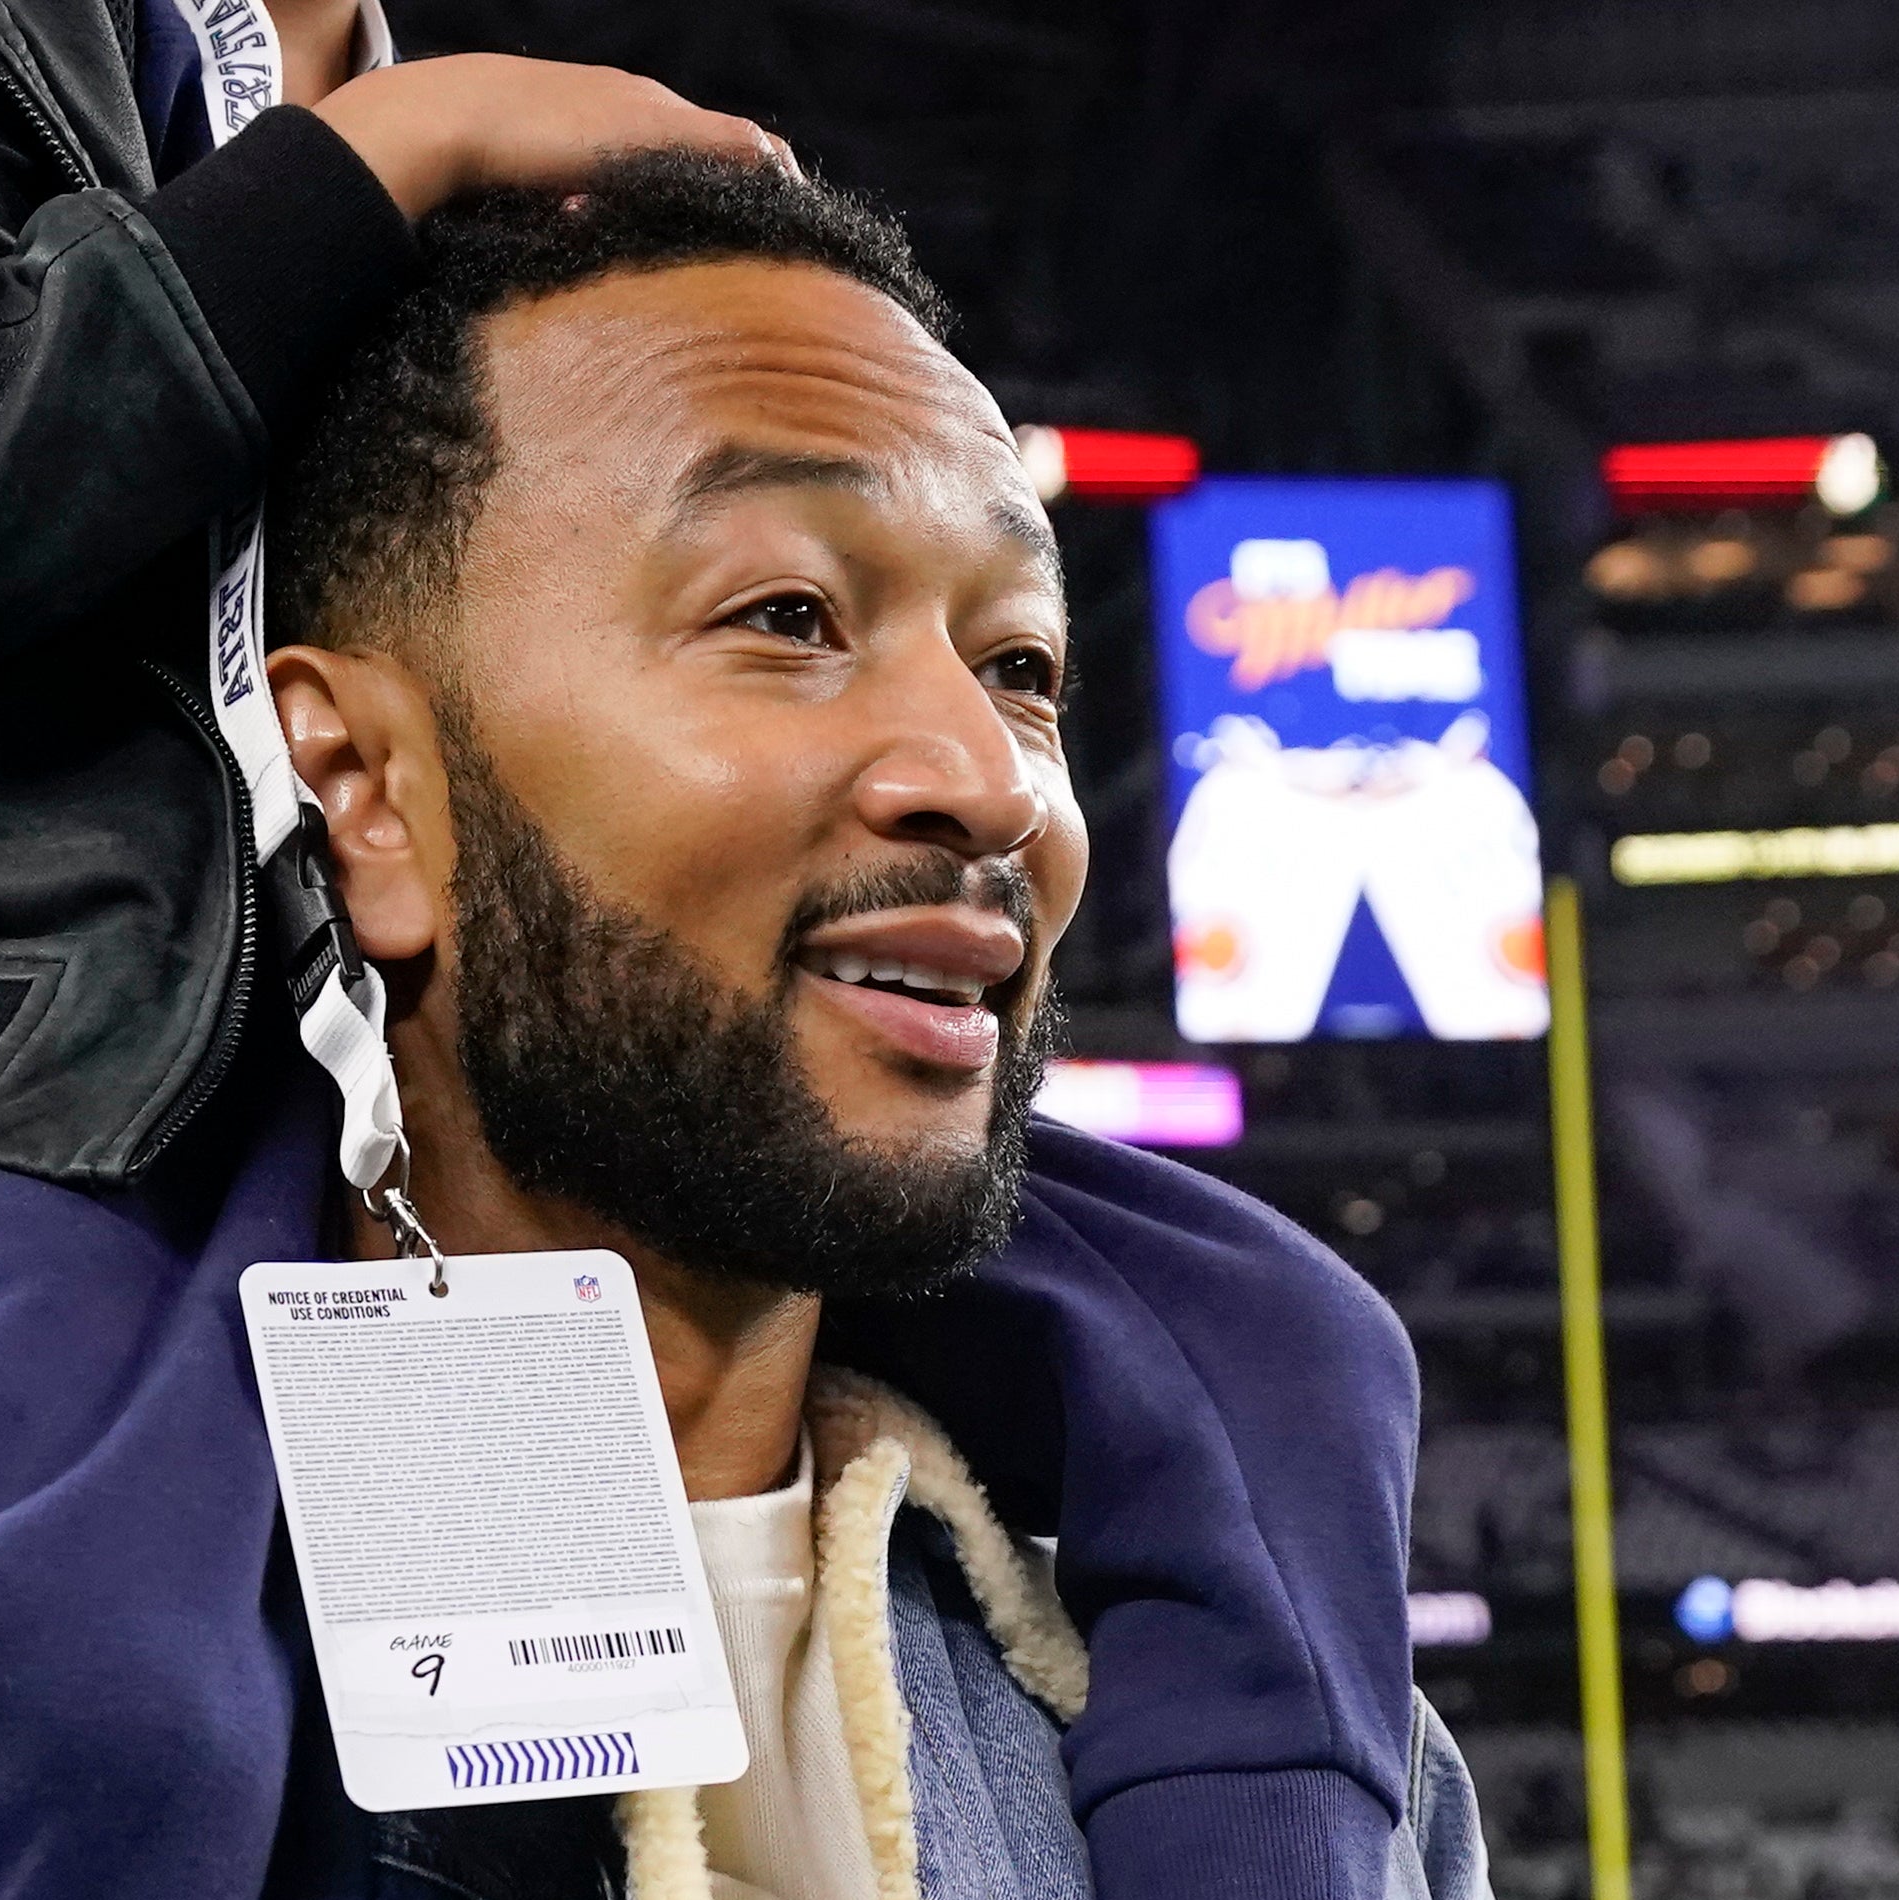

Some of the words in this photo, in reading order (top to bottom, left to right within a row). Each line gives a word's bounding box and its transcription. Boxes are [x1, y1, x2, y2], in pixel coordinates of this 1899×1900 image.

[192, 0, 267, 60] STA
[218, 61, 272, 138] T&T
[218, 568, 254, 707] AT&T
[268, 1291, 311, 1305] NOTICE
[314, 1291, 328, 1304] OF
[331, 1288, 408, 1304] CREDENTIAL
[290, 1307, 314, 1320] USE
[317, 1305, 391, 1320] CONDITIONS
[389, 1633, 453, 1651] GAME
[411, 1654, 445, 1696] 9
[567, 1659, 637, 1673] 4000011927
